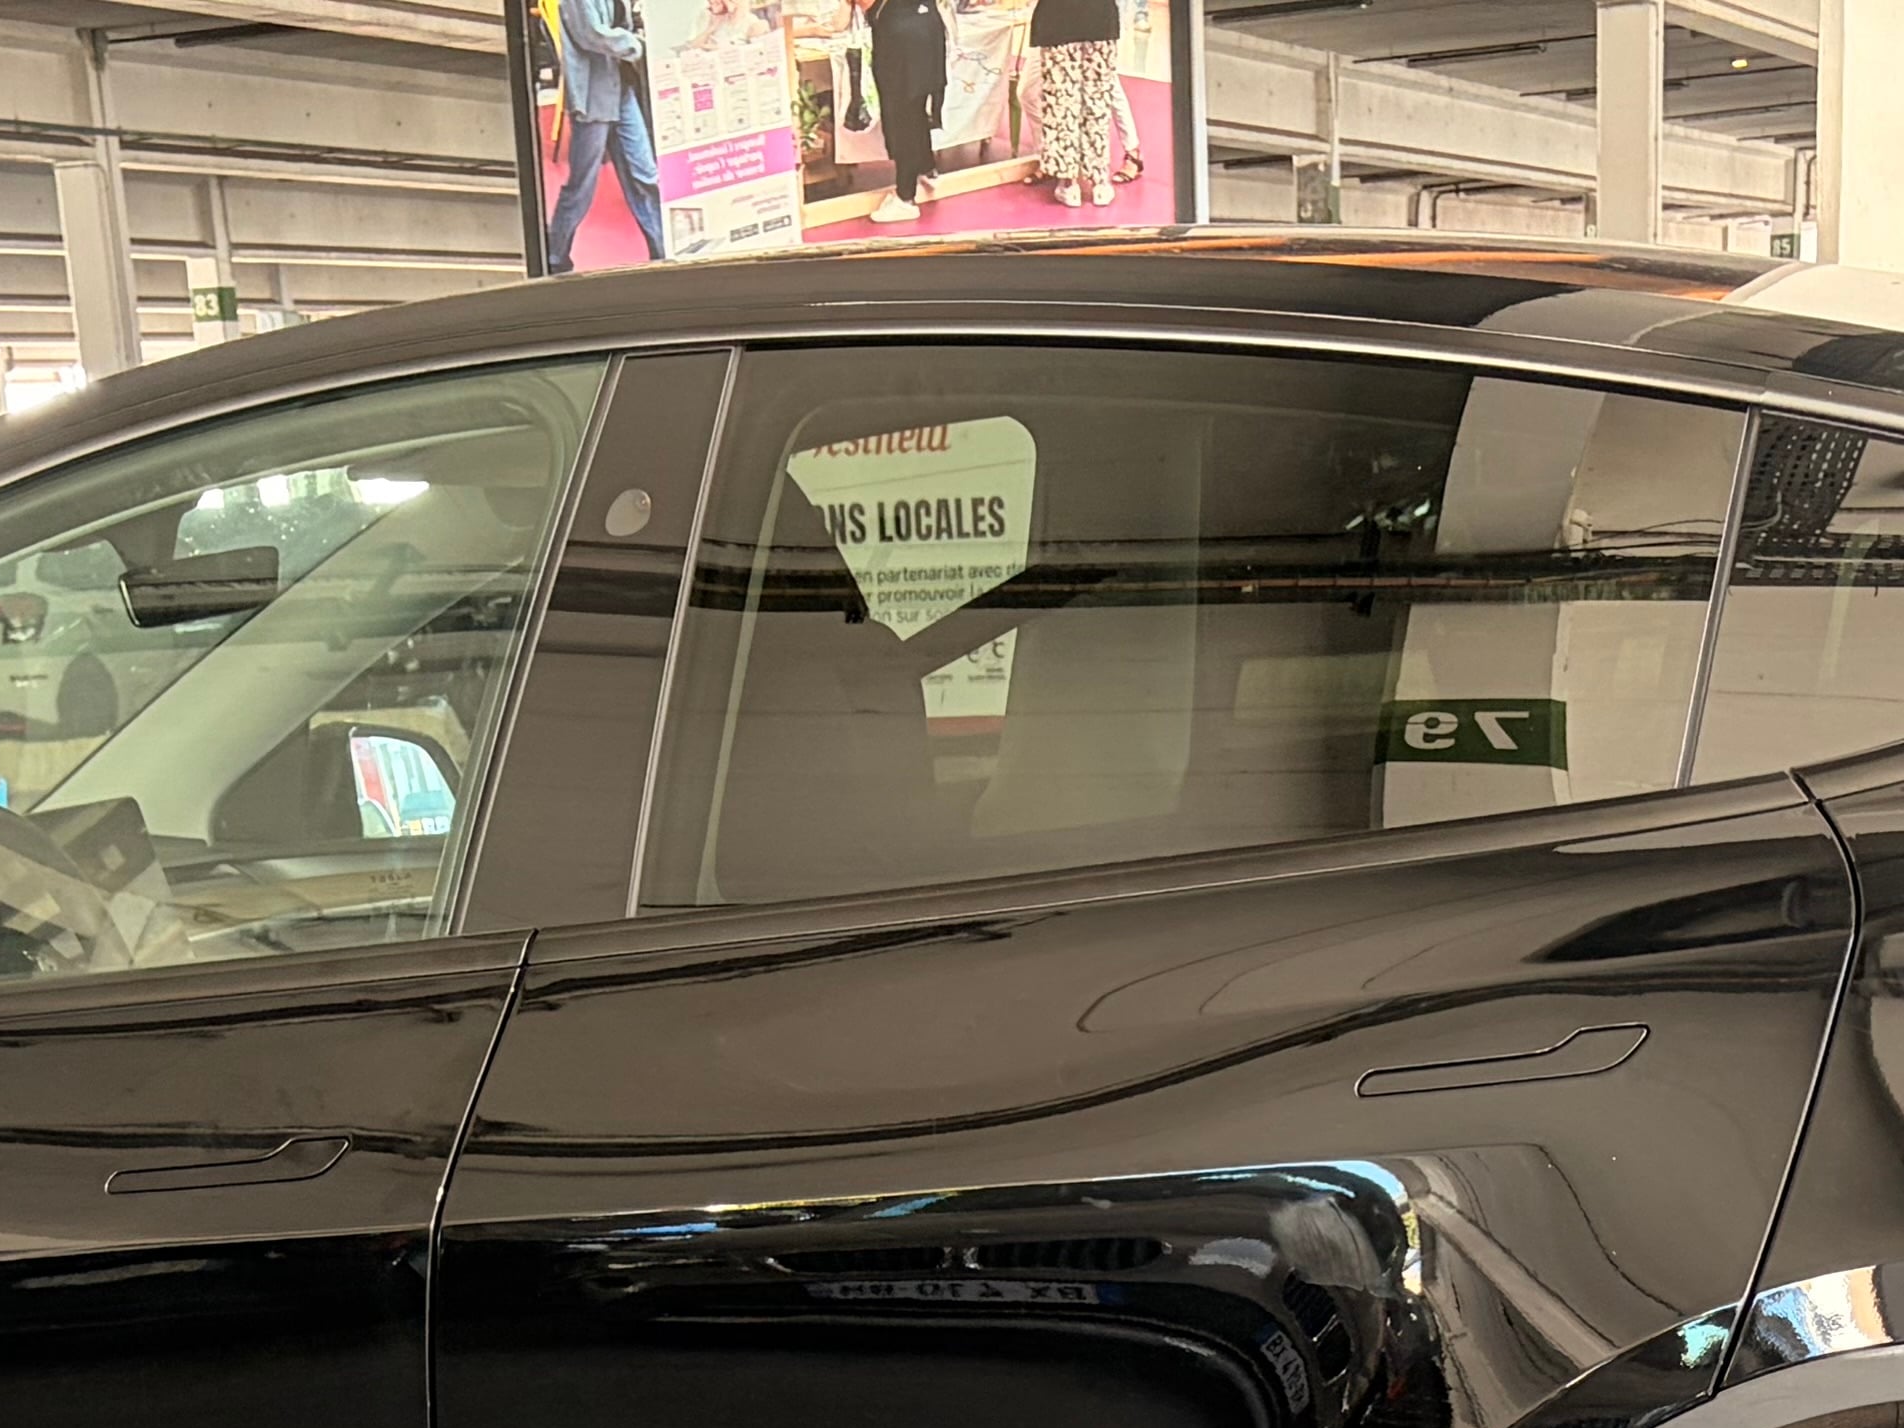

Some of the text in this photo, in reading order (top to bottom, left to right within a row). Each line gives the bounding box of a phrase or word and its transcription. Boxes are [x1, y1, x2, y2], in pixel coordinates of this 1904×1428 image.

[194, 293, 219, 317] 83
[878, 496, 1006, 543] LOCALES
[877, 564, 964, 585] partenariat
[968, 564, 1002, 579] avec
[877, 587, 965, 604] promouvoir
[896, 609, 922, 624] sur
